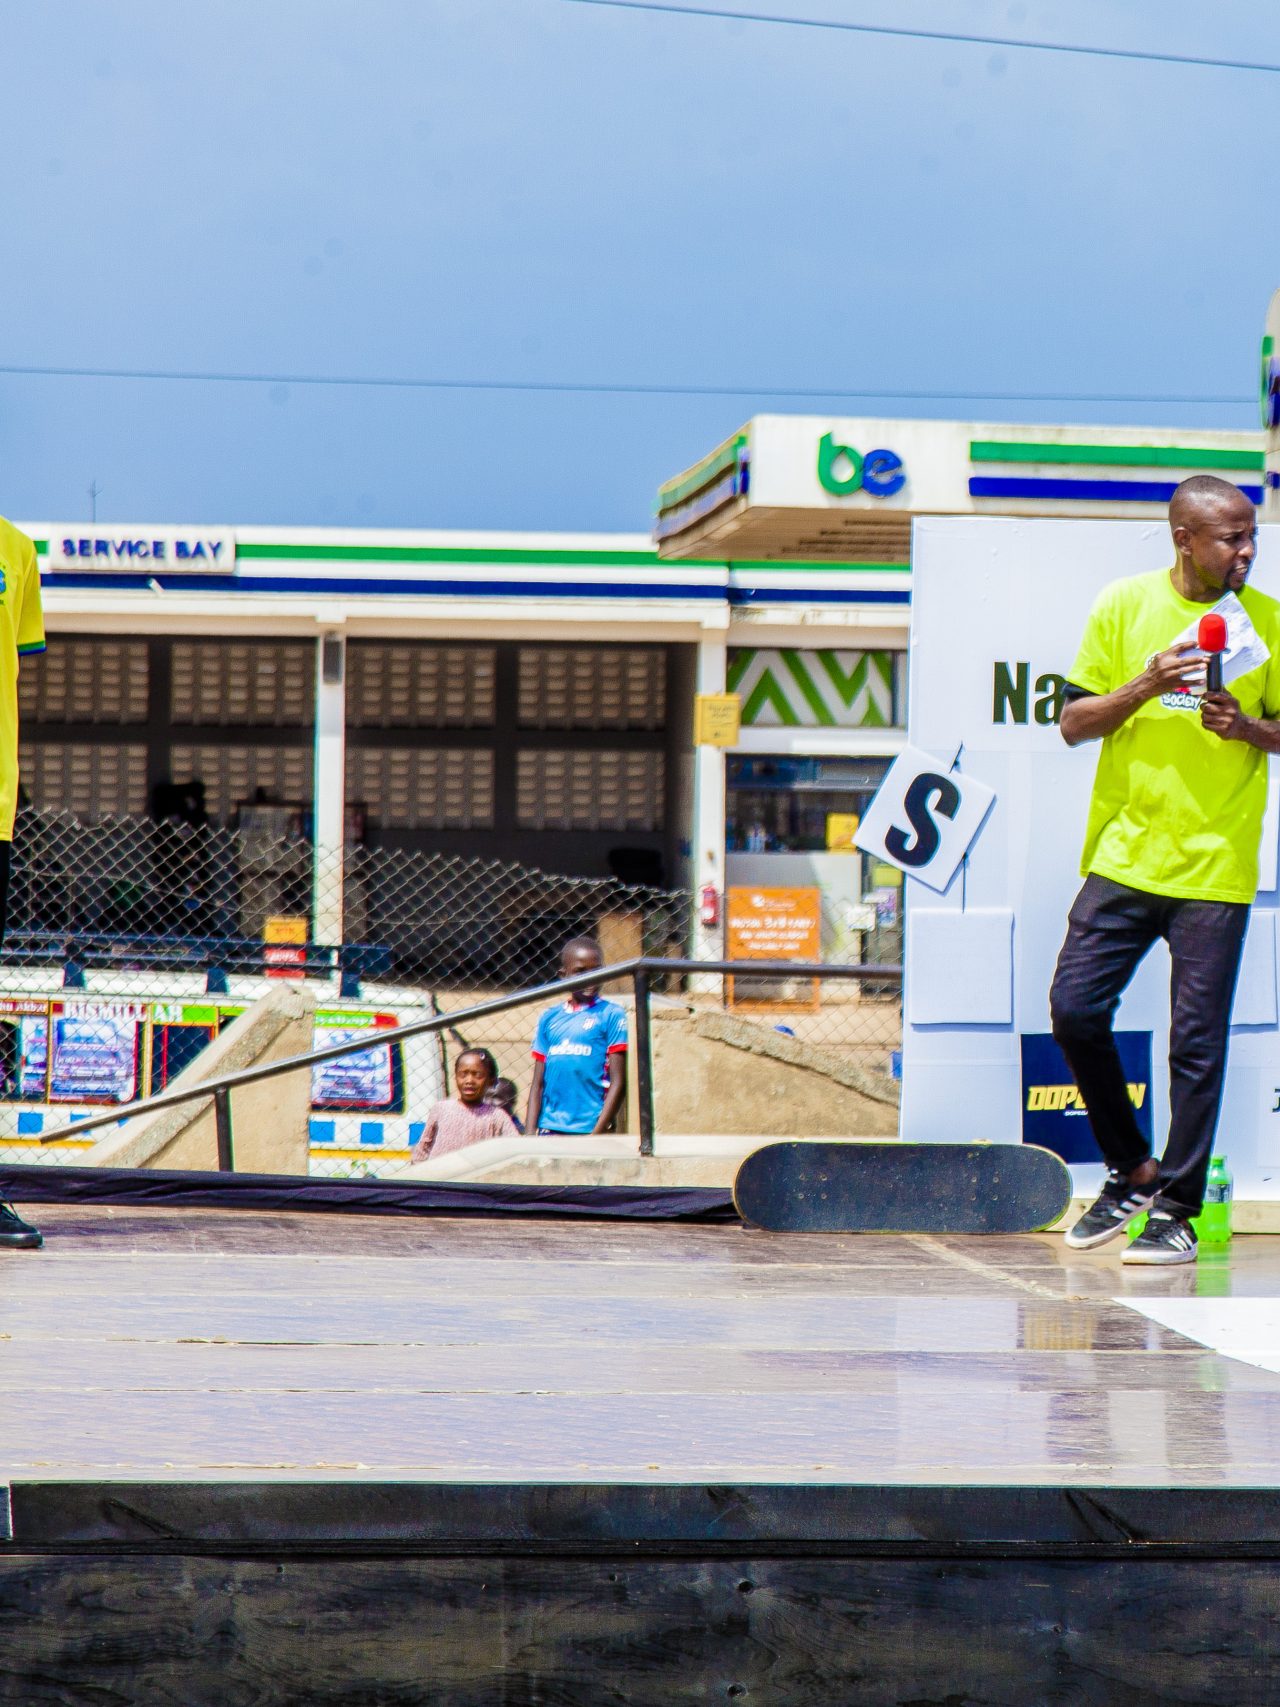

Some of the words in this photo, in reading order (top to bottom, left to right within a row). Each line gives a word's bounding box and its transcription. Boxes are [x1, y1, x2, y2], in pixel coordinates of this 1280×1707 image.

[818, 432, 906, 498] be
[63, 539, 166, 559] SERVICE
[175, 541, 223, 559] BAY
[885, 772, 960, 867] S
